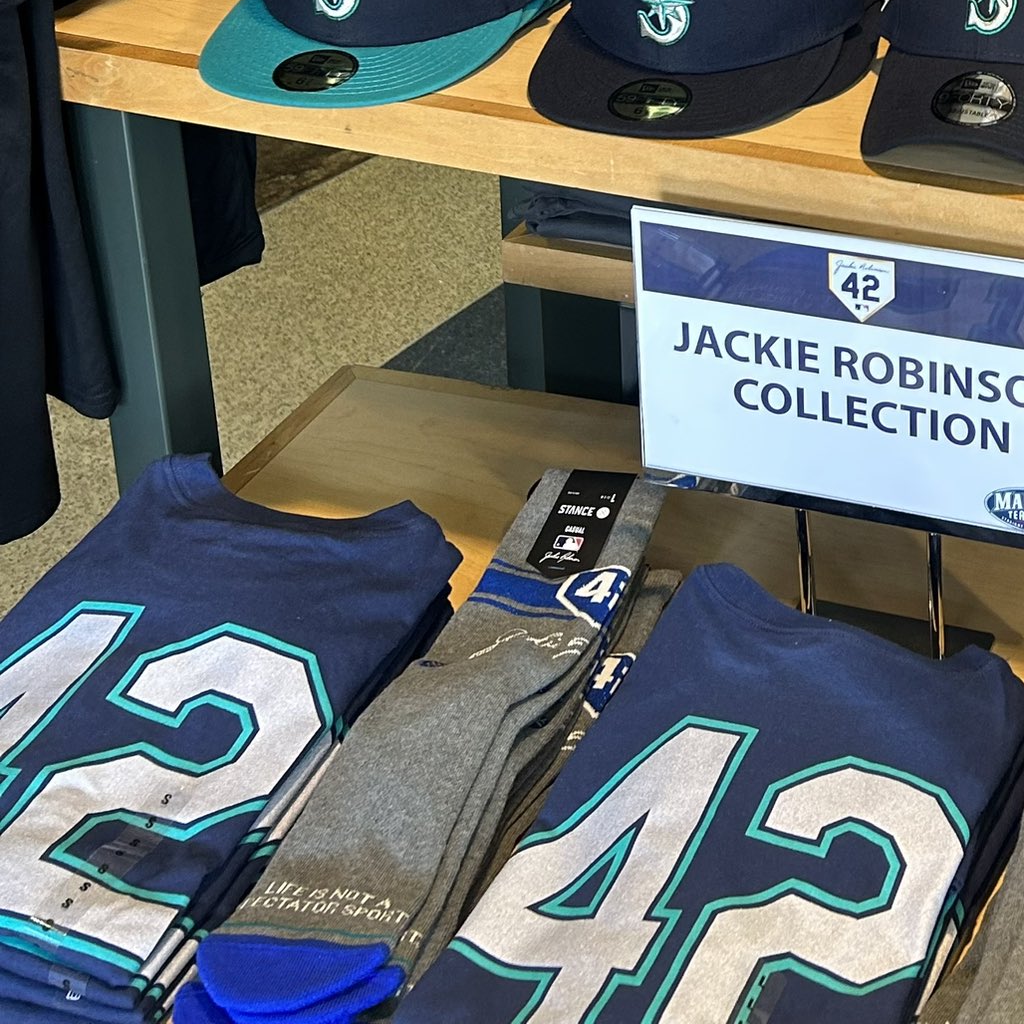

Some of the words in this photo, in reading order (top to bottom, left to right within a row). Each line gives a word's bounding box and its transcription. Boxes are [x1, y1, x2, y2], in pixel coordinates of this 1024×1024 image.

[841, 272, 880, 303] 42
[673, 322, 820, 374] JACKIE
[733, 378, 1010, 454] COLLECTION
[557, 504, 596, 517] STANCE
[564, 525, 586, 534] CASUAL
[447, 714, 970, 1024] 42
[264, 881, 308, 897] LIFE
[309, 888, 329, 899] IS
[329, 887, 375, 905] NOT
[375, 897, 392, 909] A
[341, 904, 410, 924] SPORT
